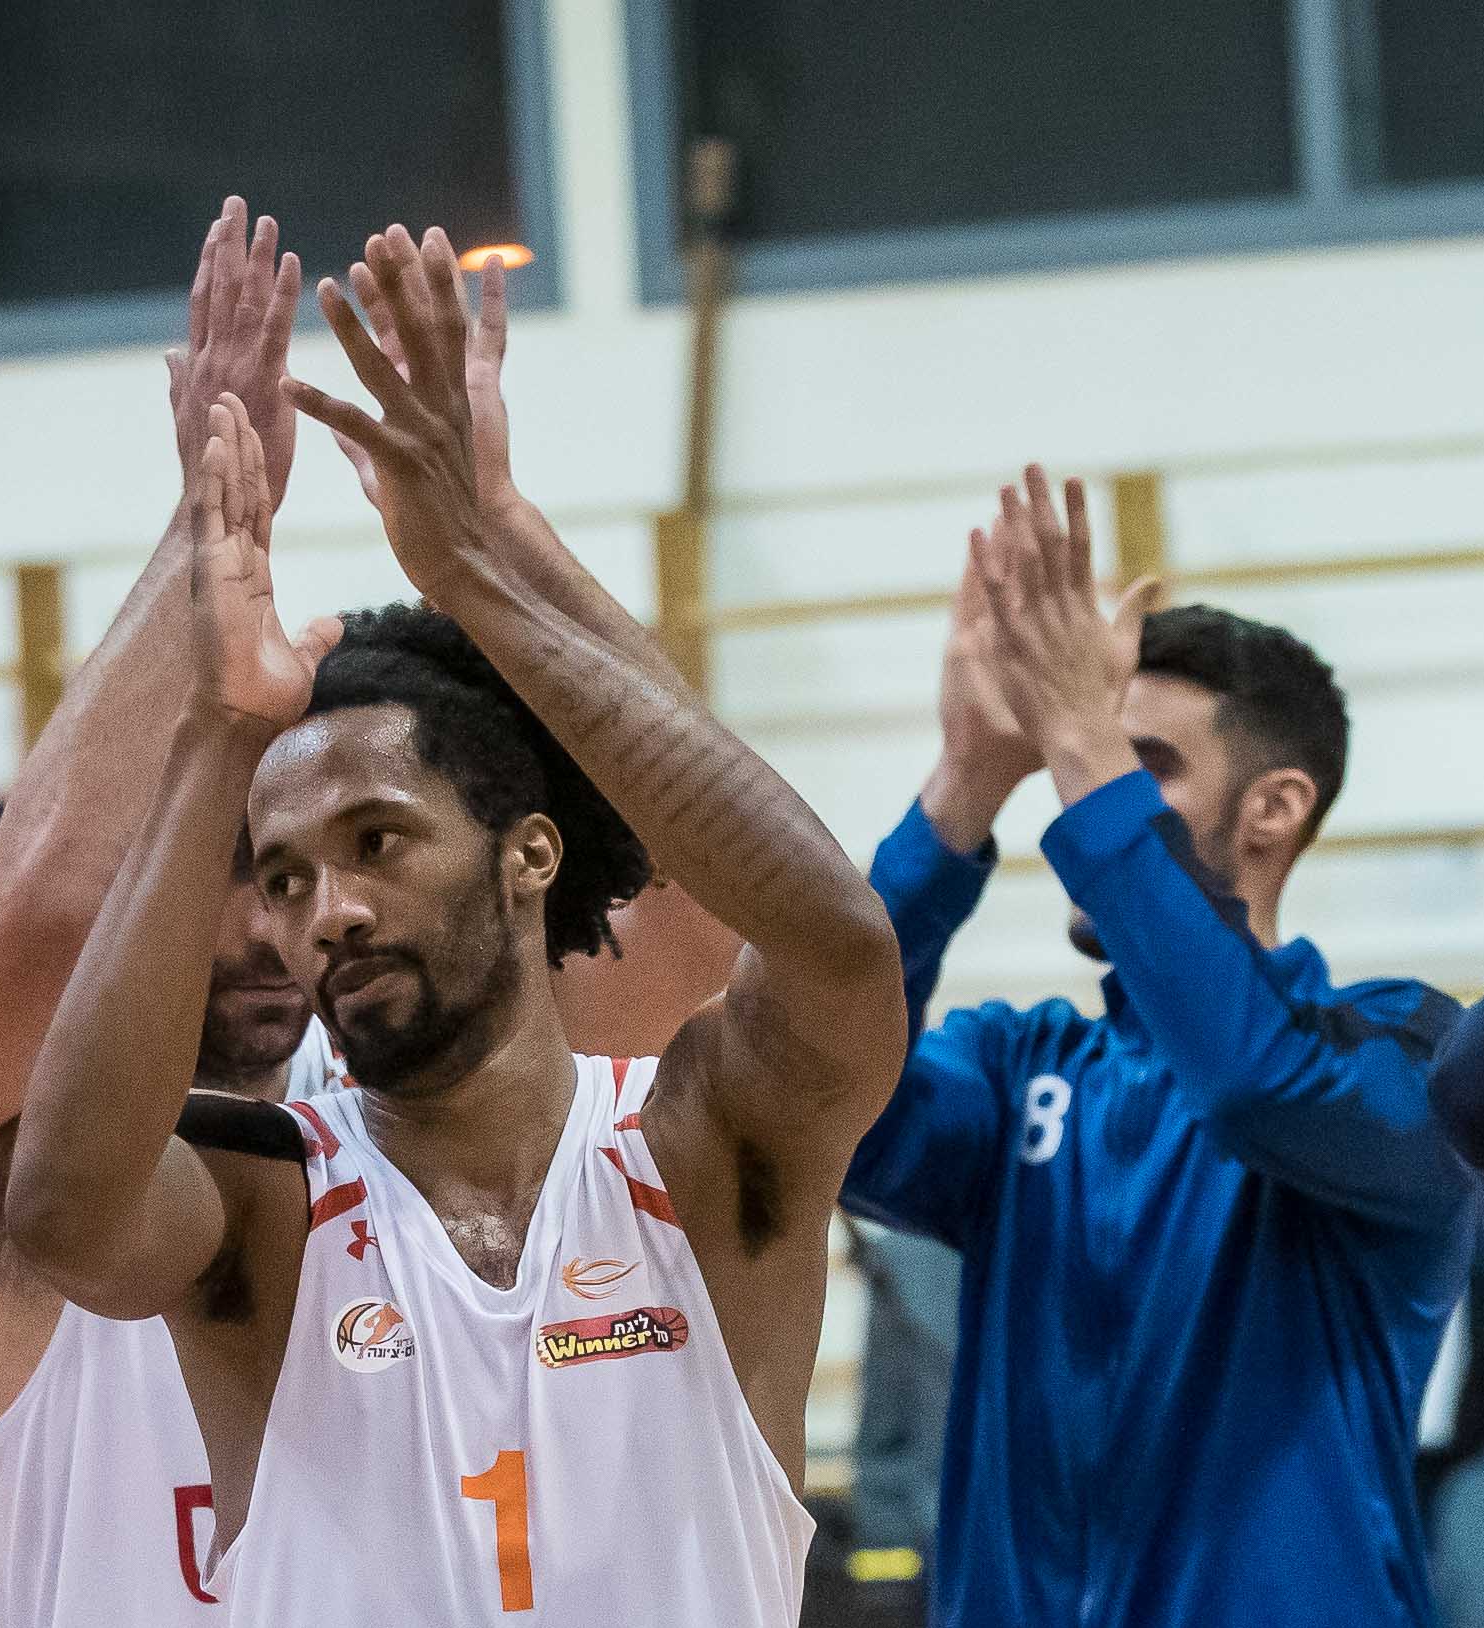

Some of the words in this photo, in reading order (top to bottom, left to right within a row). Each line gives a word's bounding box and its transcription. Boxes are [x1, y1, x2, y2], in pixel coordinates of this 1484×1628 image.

[1021, 1073, 1073, 1166] 8
[614, 1313, 650, 1336] ליגת
[653, 1324, 669, 1344] סל
[546, 1330, 652, 1360] Winner
[460, 1450, 534, 1612] 1
